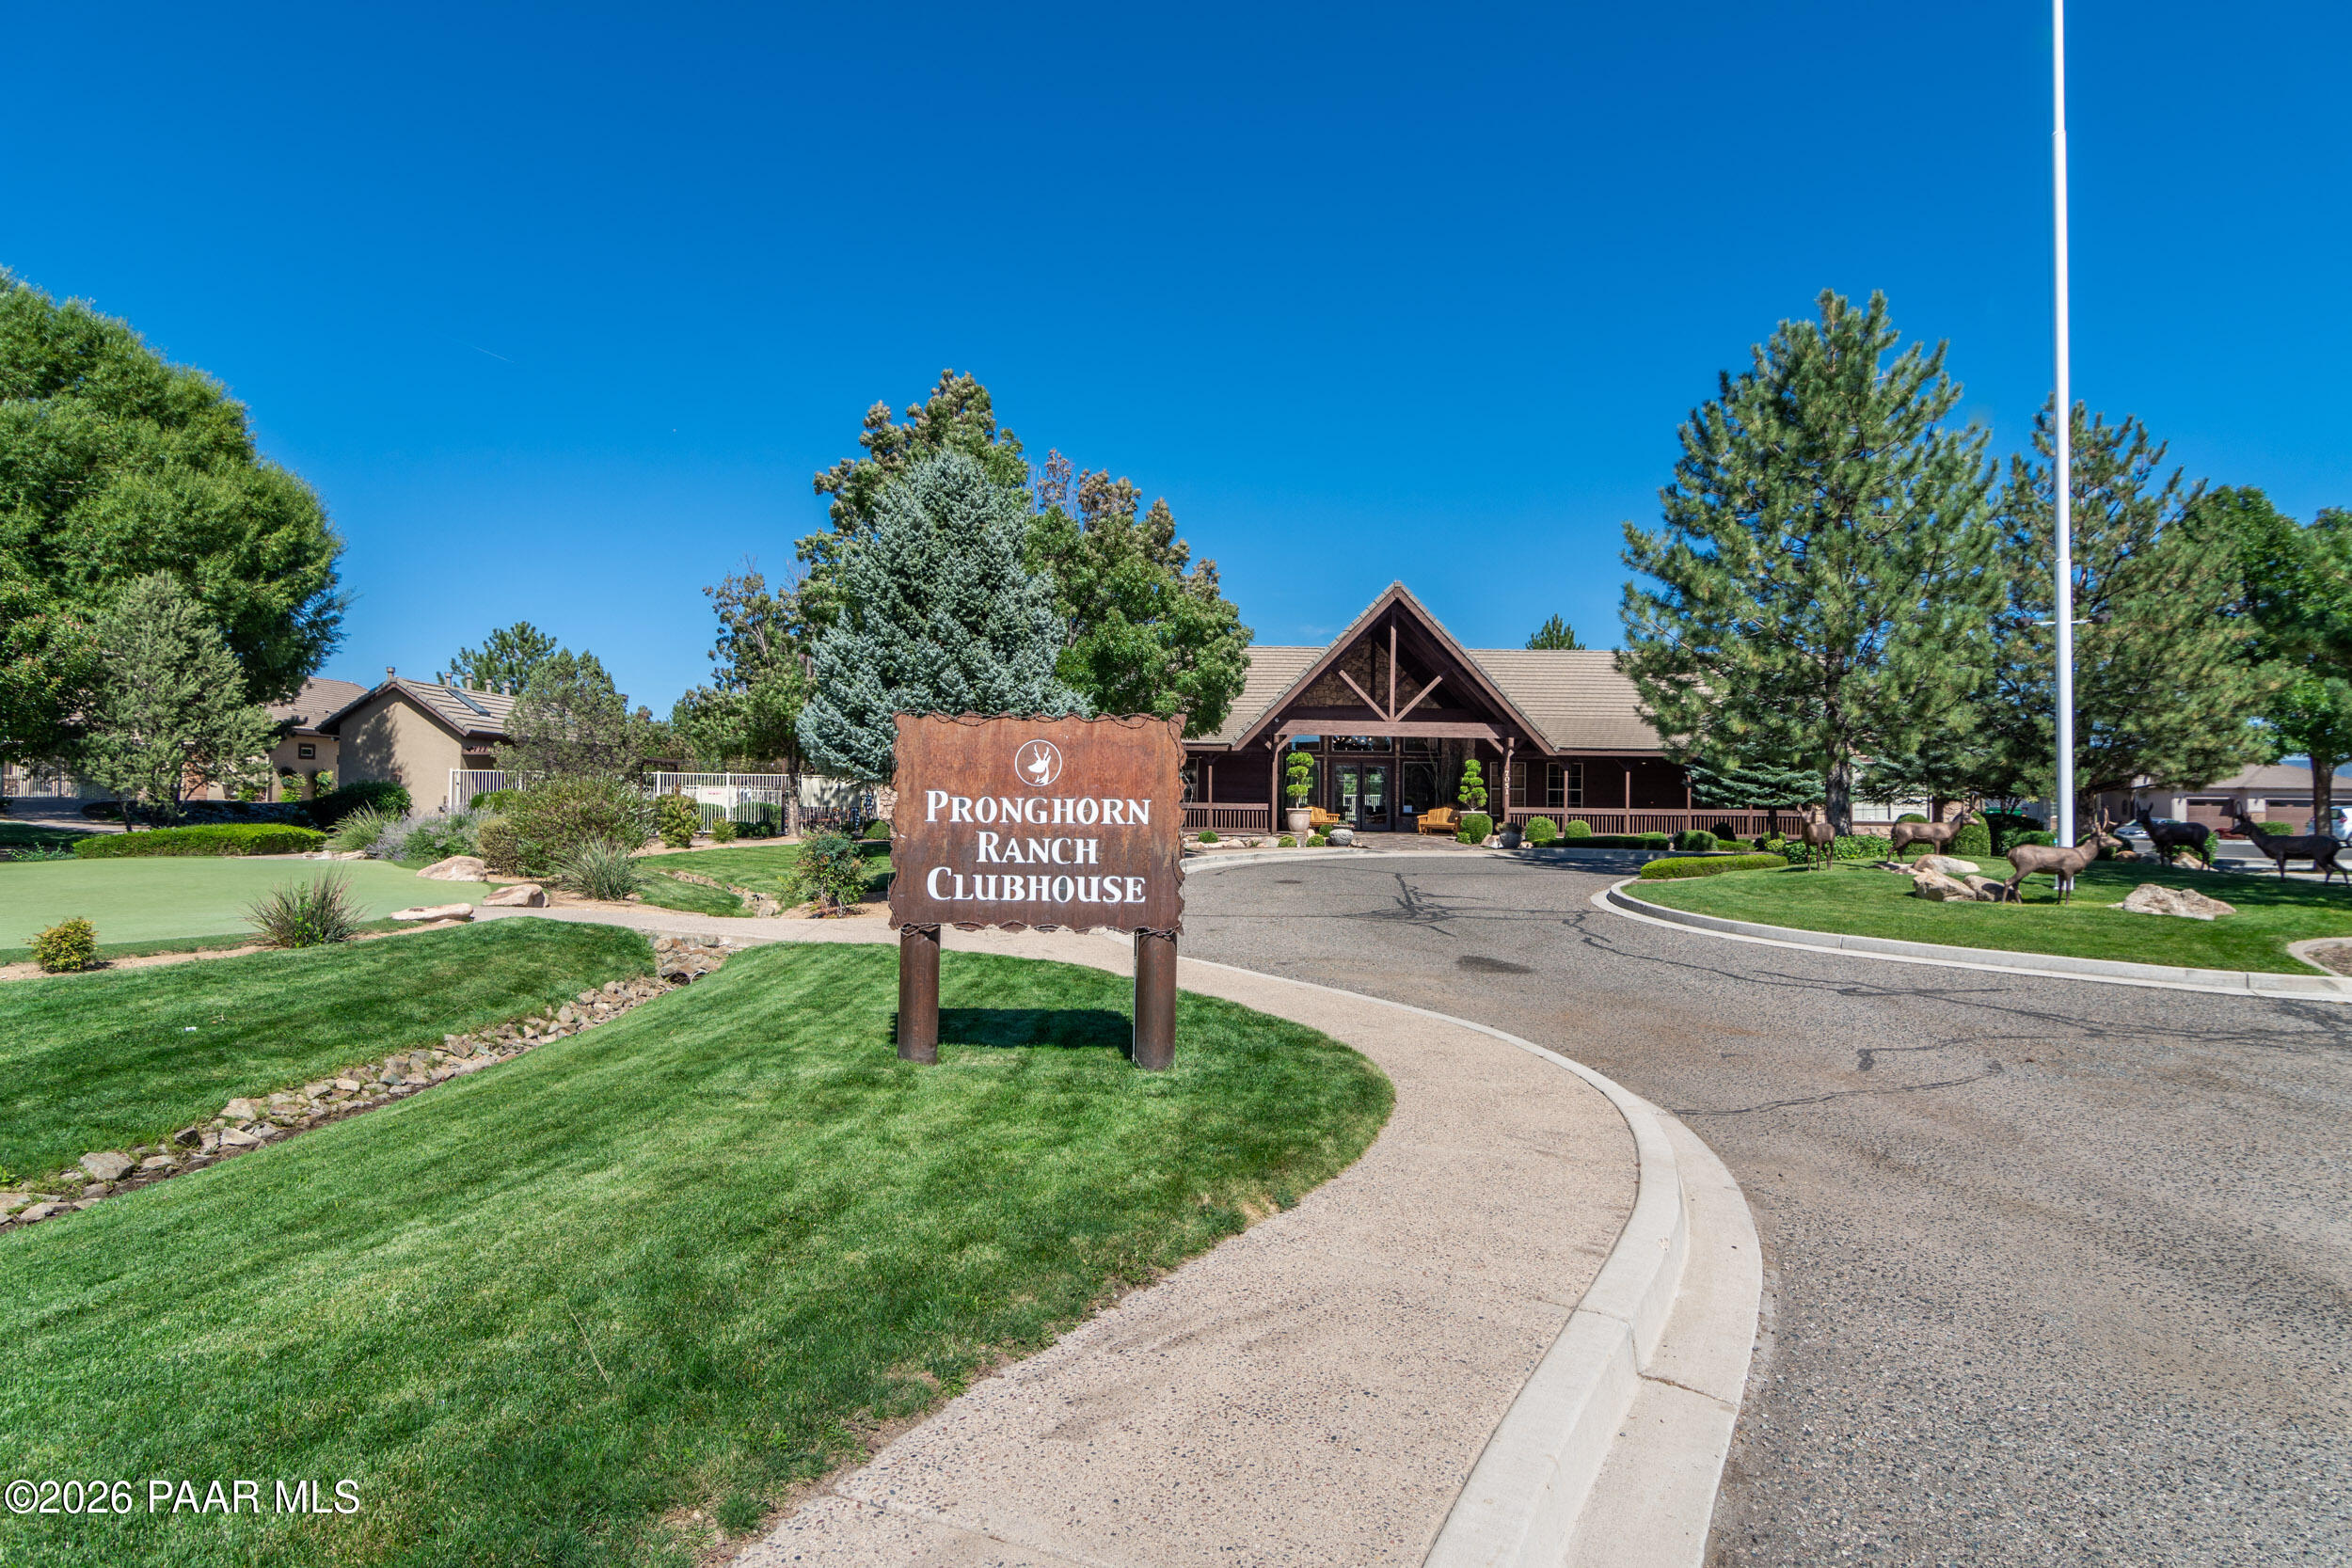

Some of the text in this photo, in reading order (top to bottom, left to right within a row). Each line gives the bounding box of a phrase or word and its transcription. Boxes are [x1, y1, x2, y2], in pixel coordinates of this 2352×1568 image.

[925, 790, 1152, 826] PRONGHORN
[976, 831, 1099, 865] RANCH
[927, 866, 1147, 904] CLUBHOUSE
